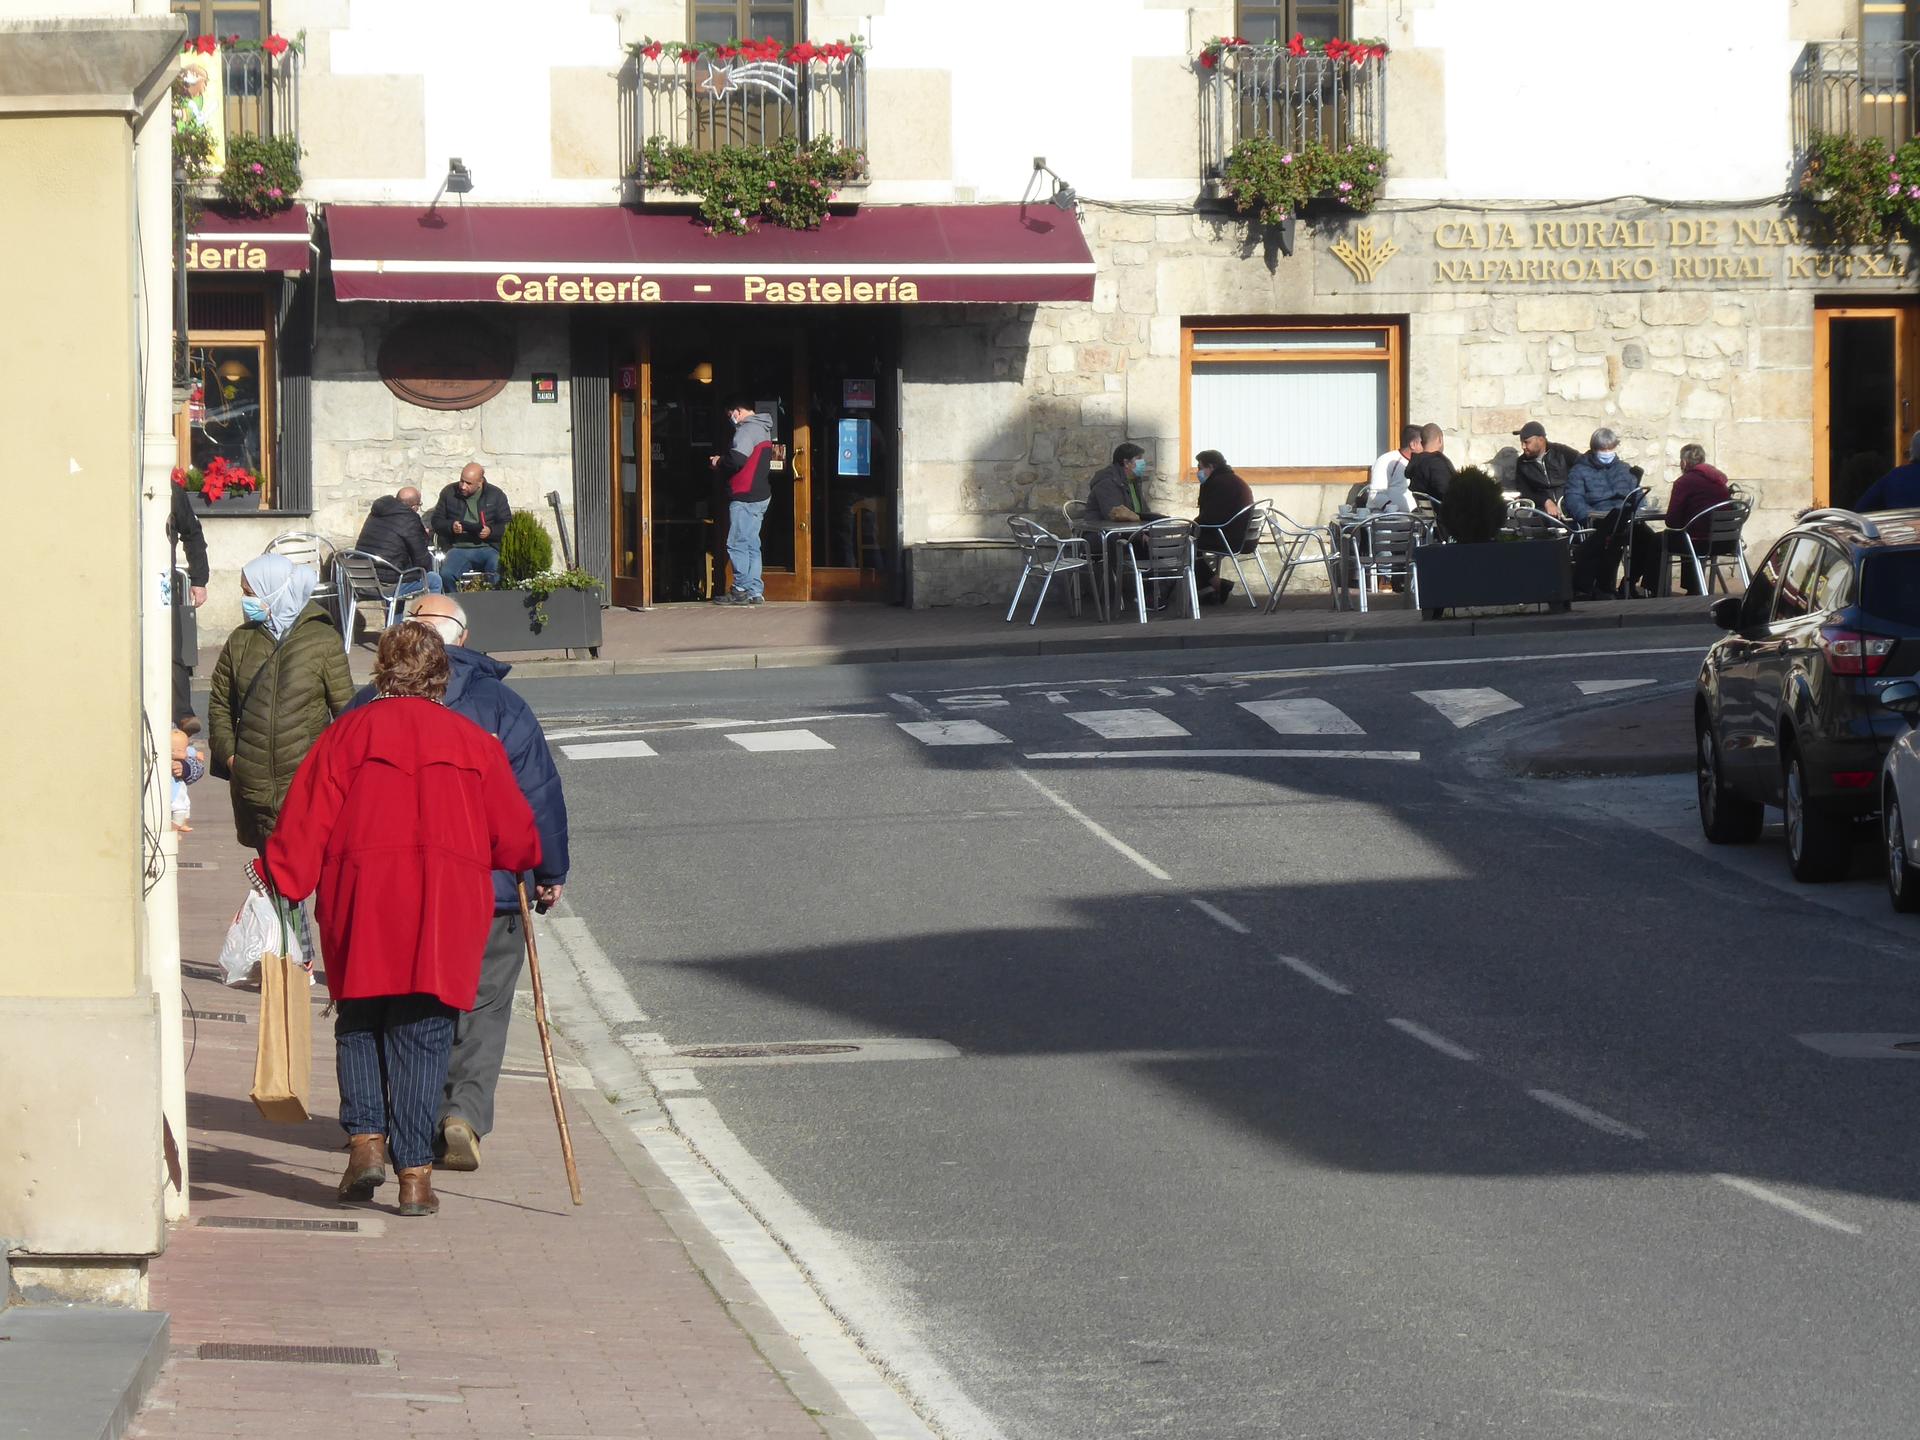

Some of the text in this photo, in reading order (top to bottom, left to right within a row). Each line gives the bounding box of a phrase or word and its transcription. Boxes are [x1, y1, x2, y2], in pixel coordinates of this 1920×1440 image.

[1435, 221, 1522, 250] CAJA
[1534, 219, 1658, 248] RURAL
[1669, 219, 1720, 247] DE
[172, 241, 267, 269] dería
[1435, 256, 1658, 281] NAFARROAKO
[1672, 255, 1774, 279] RURAL
[496, 274, 662, 302] Cafetería
[744, 275, 919, 302] Pastelería
